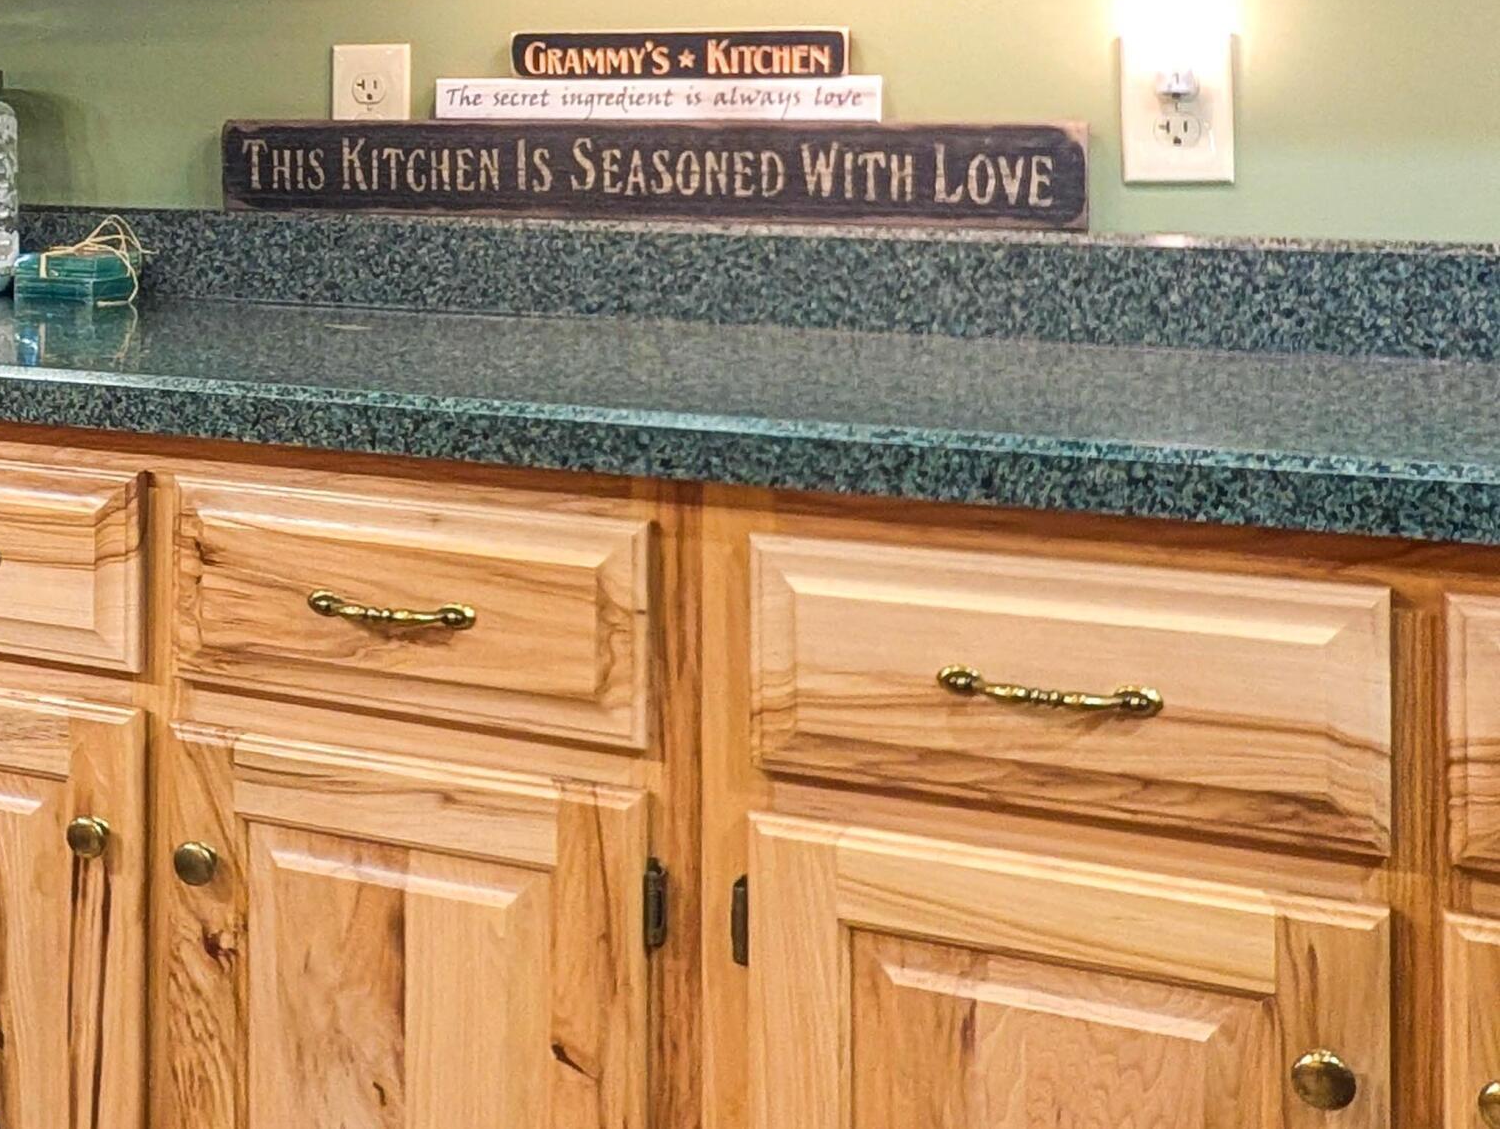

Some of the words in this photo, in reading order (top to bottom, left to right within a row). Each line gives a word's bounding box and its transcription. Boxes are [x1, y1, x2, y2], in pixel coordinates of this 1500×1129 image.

[706, 38, 831, 75] KITCHEN
[445, 84, 483, 108] The
[493, 87, 551, 108] secret
[561, 86, 675, 122] ingredient
[686, 87, 702, 107] is
[713, 86, 801, 121] always
[814, 85, 864, 107] love
[933, 142, 1054, 207] LOVE
